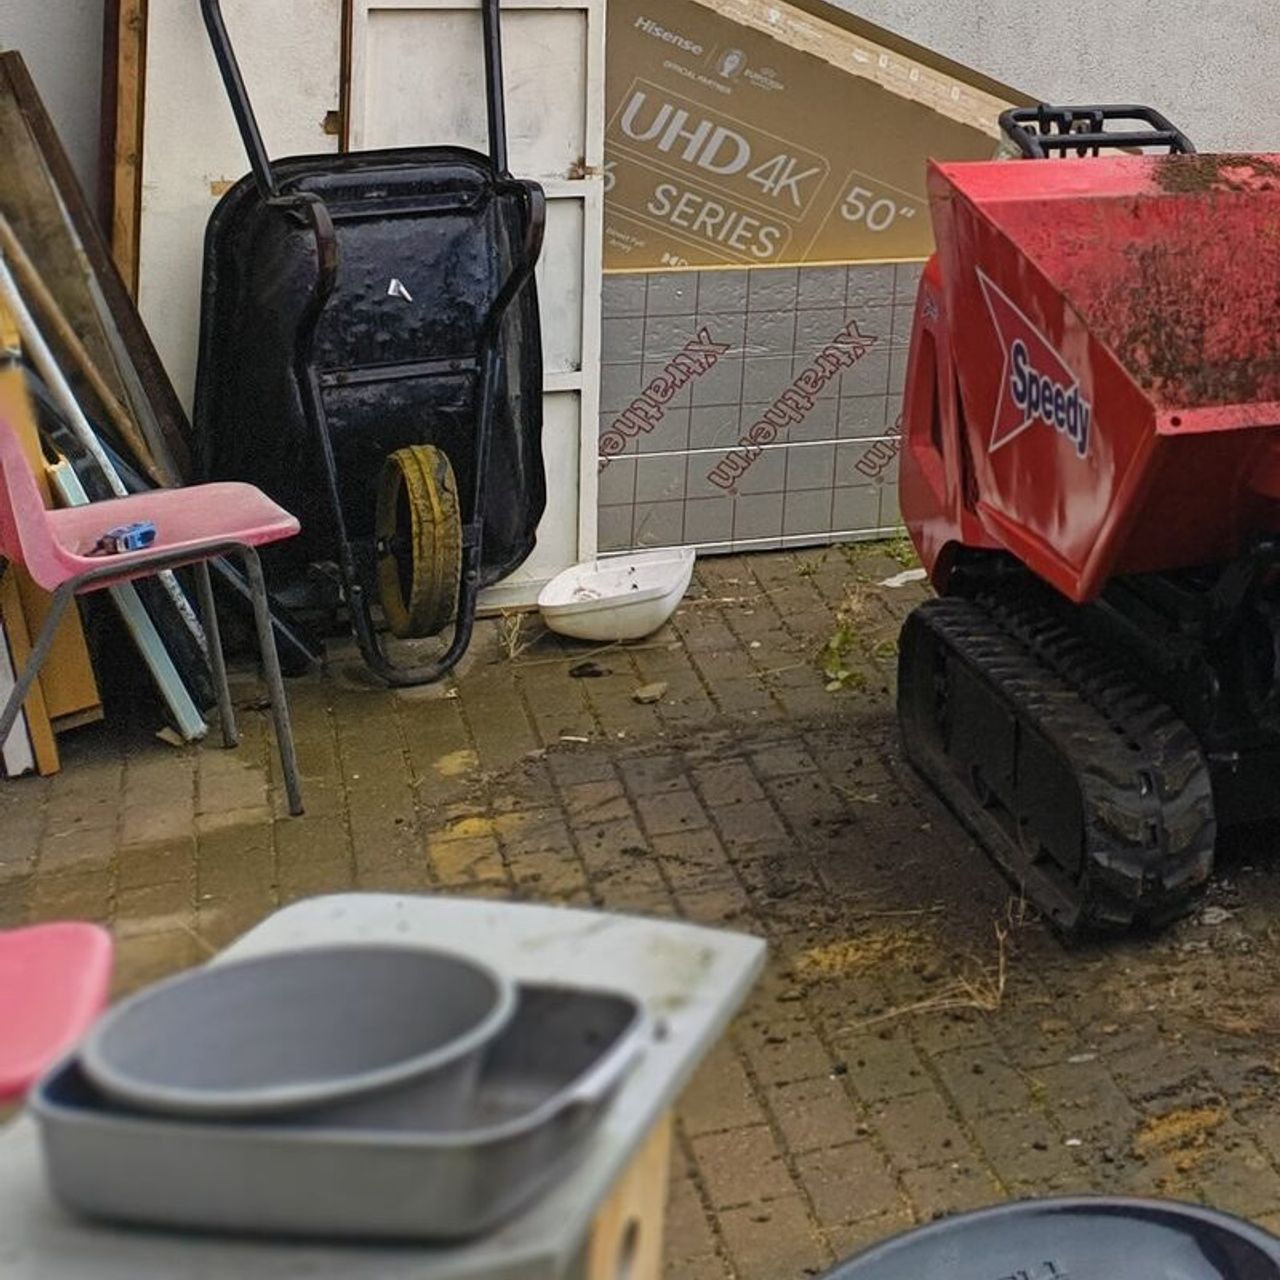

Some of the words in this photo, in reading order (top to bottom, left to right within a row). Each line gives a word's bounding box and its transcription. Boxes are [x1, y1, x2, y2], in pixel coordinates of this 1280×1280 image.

[634, 15, 704, 56] Hisense
[620, 91, 751, 176] UHD
[747, 154, 820, 209] 4K
[647, 183, 782, 259] SERIES
[1010, 338, 1091, 459] Speedy
